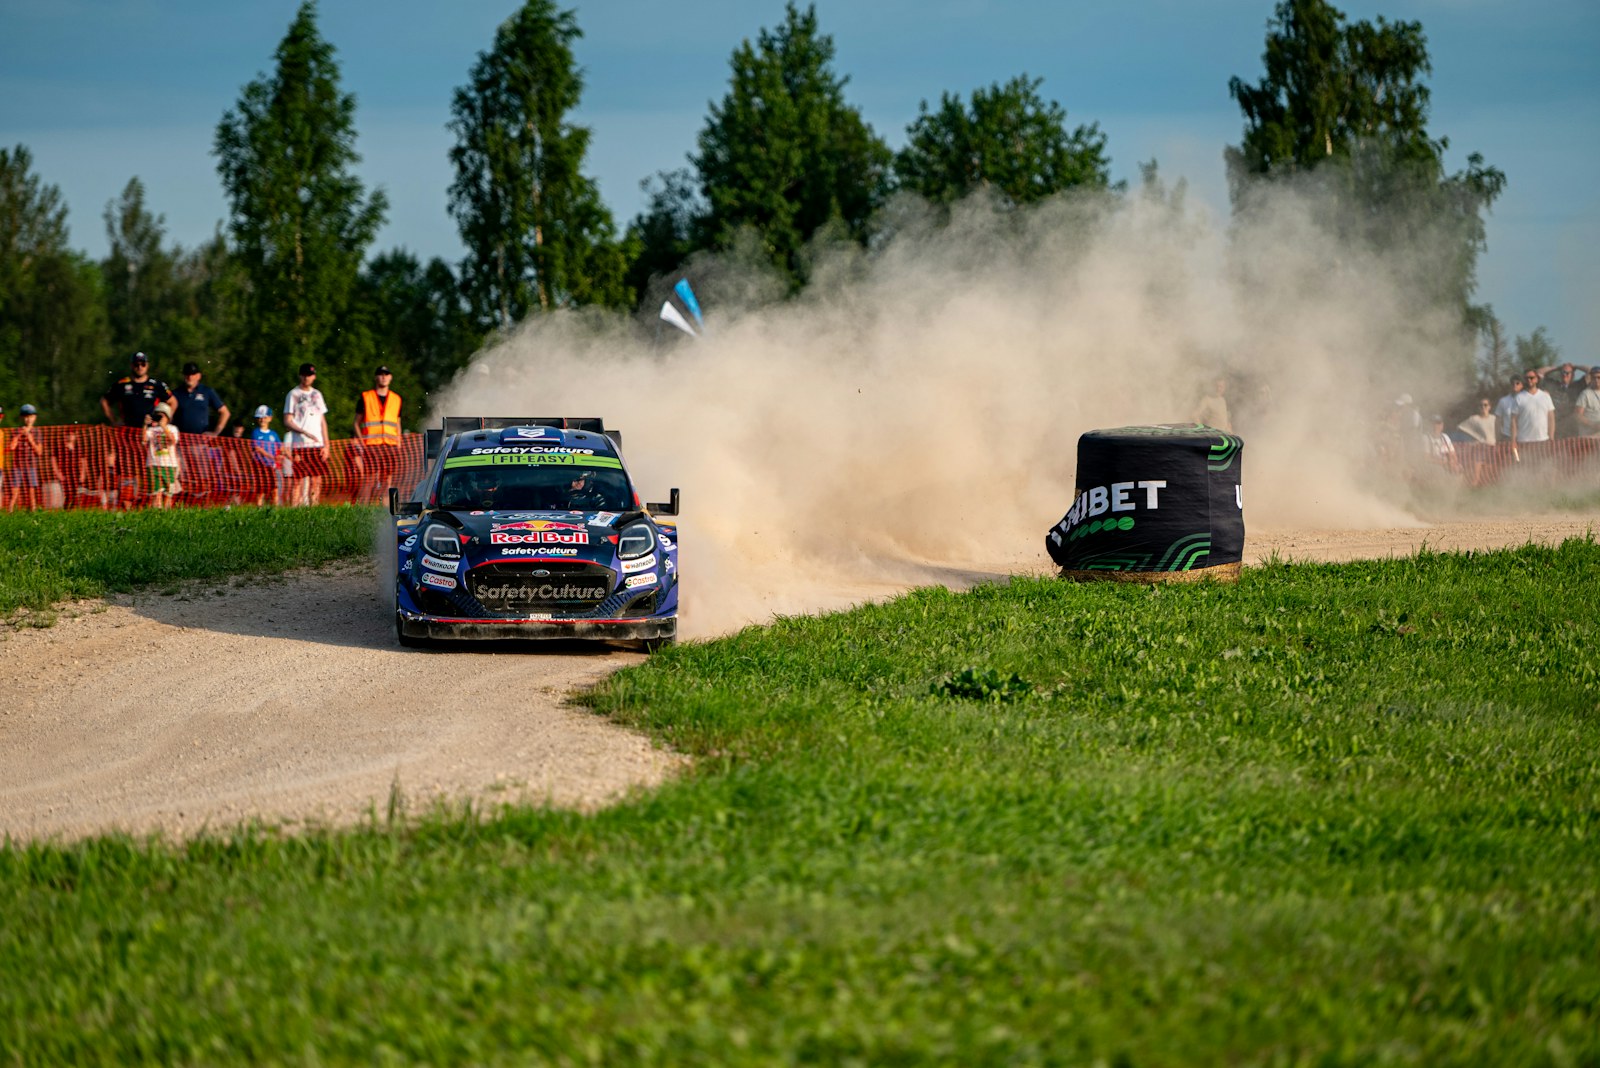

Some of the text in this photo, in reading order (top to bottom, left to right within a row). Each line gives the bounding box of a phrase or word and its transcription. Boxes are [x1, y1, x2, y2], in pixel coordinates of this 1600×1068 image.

[471, 446, 594, 455] SafetyCulture
[491, 532, 590, 544] Red Bull
[502, 547, 578, 556] SafetyCulture
[429, 575, 456, 588] Castrol
[632, 575, 656, 586] Castrol
[476, 583, 606, 603] SafetyCulture
